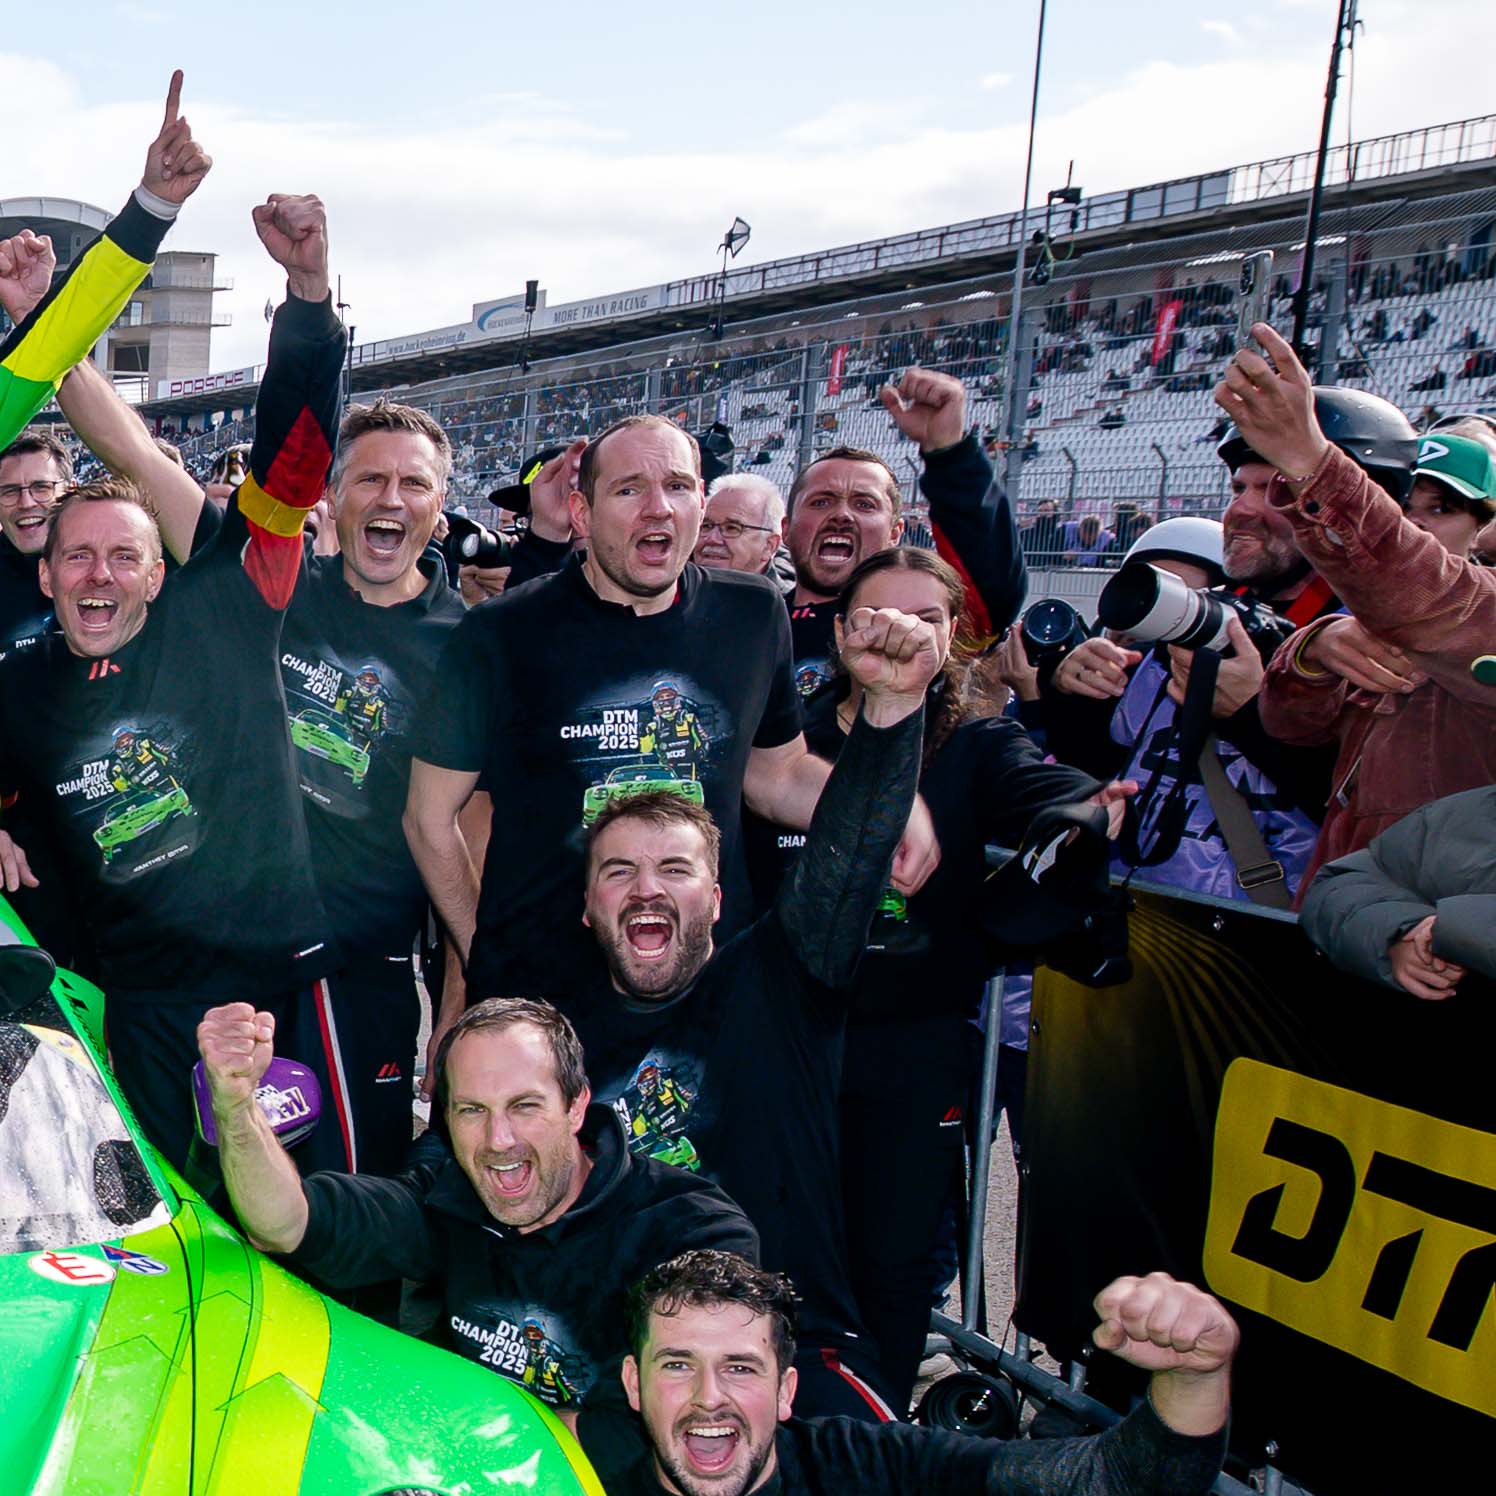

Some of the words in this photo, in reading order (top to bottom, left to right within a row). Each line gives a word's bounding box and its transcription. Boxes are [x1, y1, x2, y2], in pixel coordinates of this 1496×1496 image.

[552, 308, 579, 325] MORE
[581, 302, 607, 320] THAN
[609, 294, 649, 315] RACING
[170, 370, 244, 399] PORSCHE
[281, 653, 340, 692] CHAMPION
[318, 658, 343, 682] DTM
[302, 678, 337, 703] 2025
[602, 709, 639, 724] DTM
[560, 722, 639, 739] CHAMPION
[597, 735, 639, 750] 2025
[82, 759, 110, 778] DTM
[55, 771, 109, 797] CHAMPION
[85, 781, 116, 801] 2025
[450, 1315, 530, 1361] CHAMPION
[496, 1319, 525, 1345] DT
[479, 1345, 527, 1376] 2025
